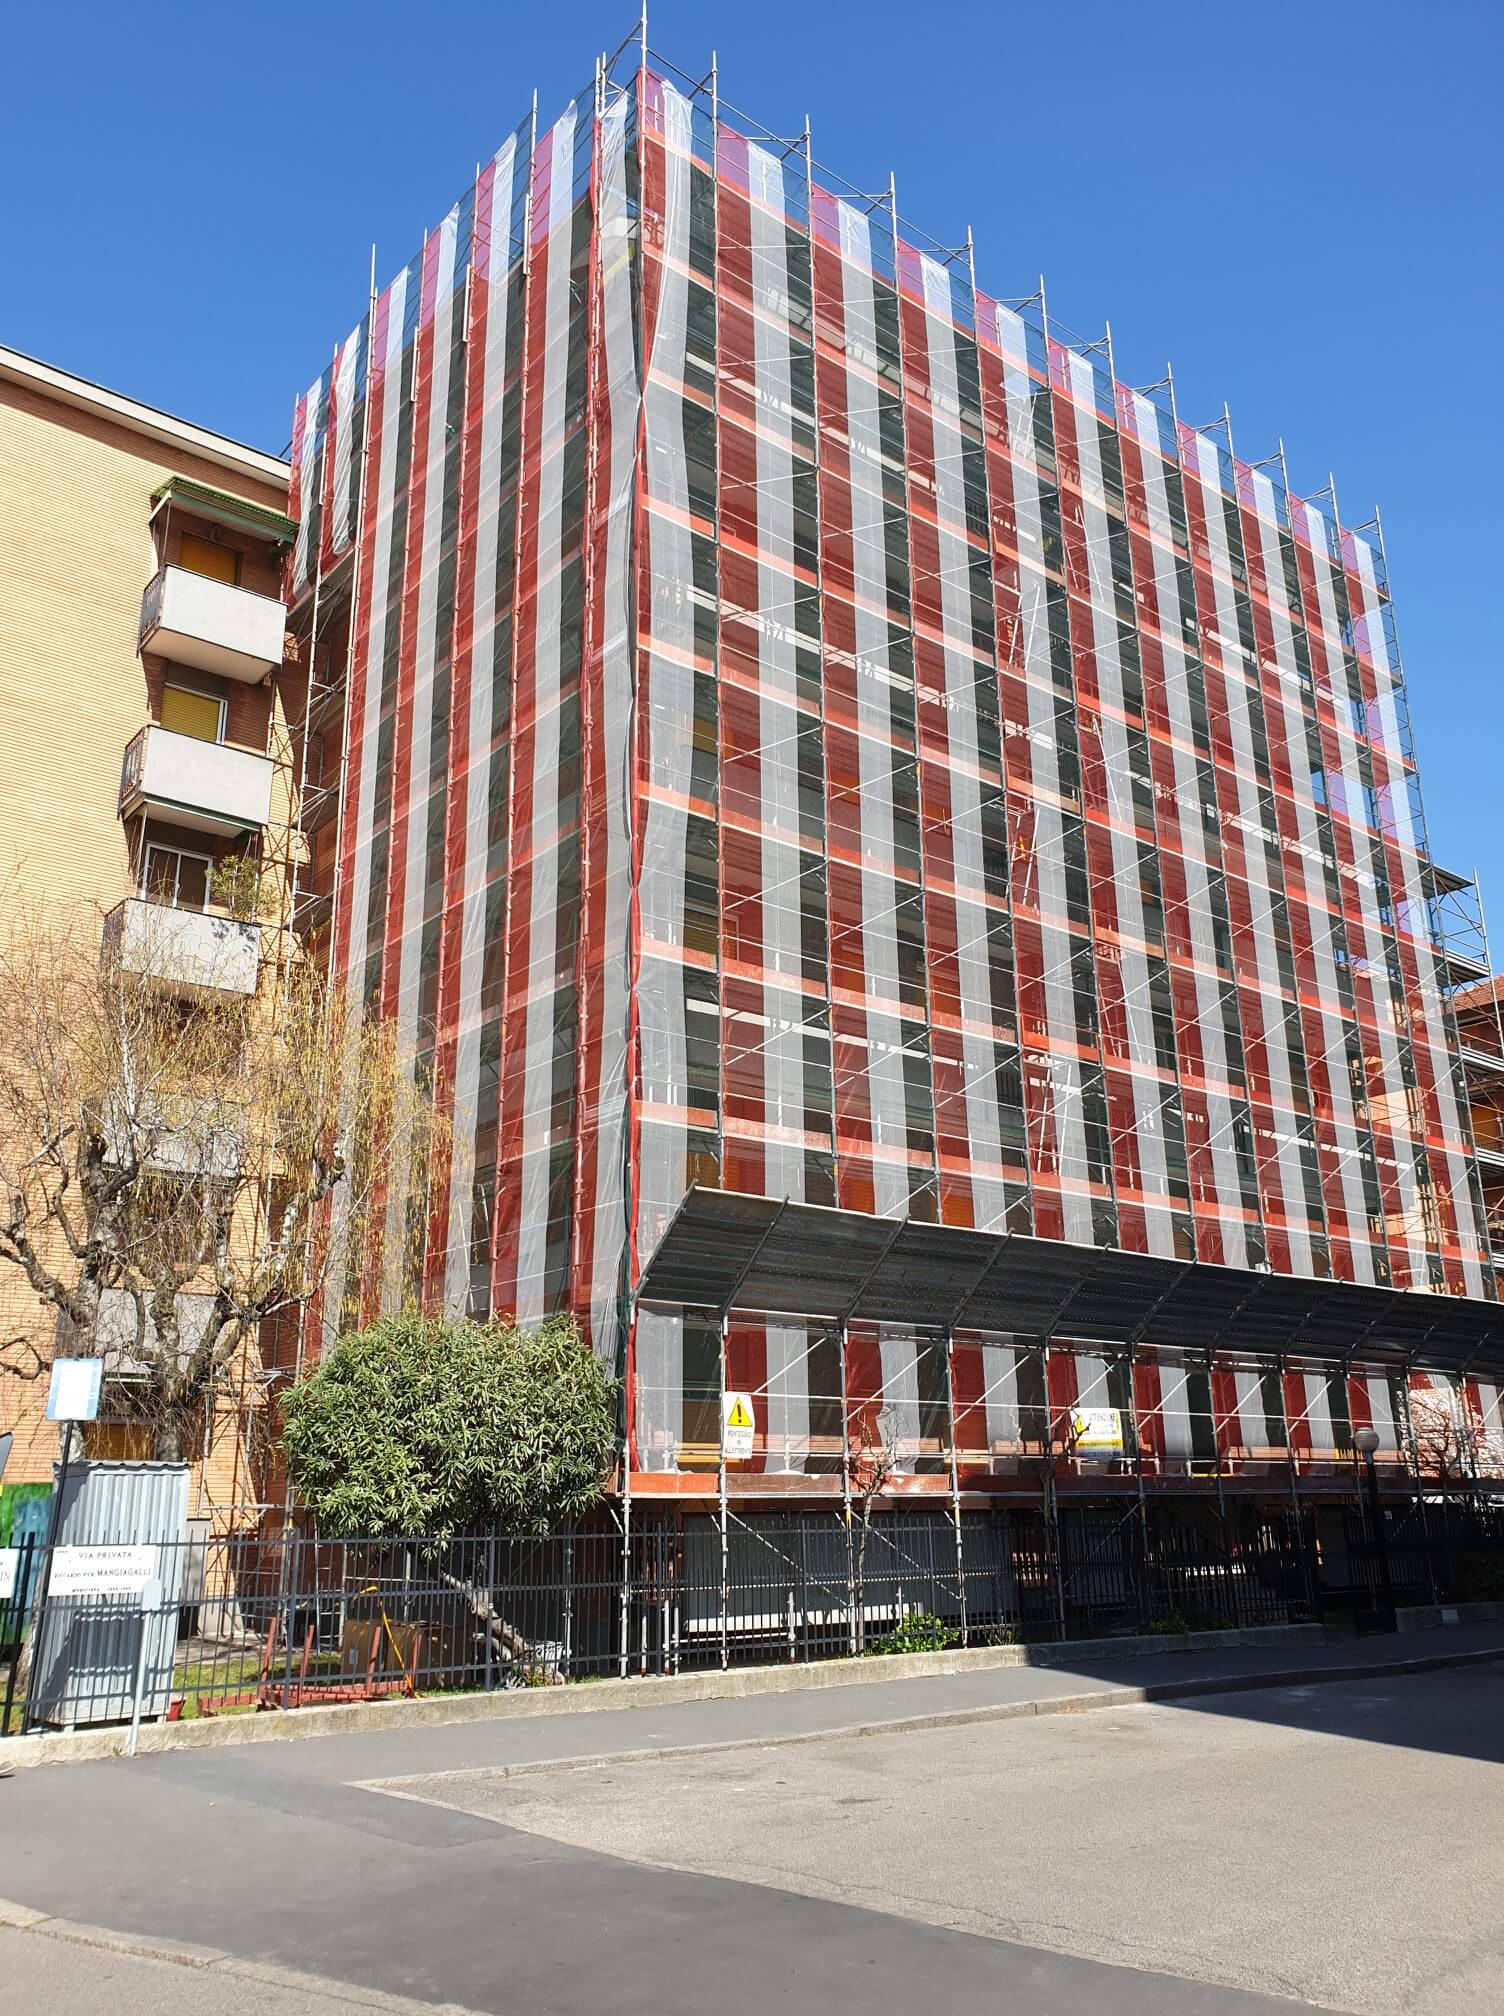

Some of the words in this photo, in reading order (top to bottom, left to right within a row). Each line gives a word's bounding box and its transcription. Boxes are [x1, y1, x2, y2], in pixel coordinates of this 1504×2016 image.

[78, 1551, 94, 1559] VIA
[96, 1551, 132, 1559] PRIVATA
[96, 1567, 151, 1577] MANGIAGALLI
